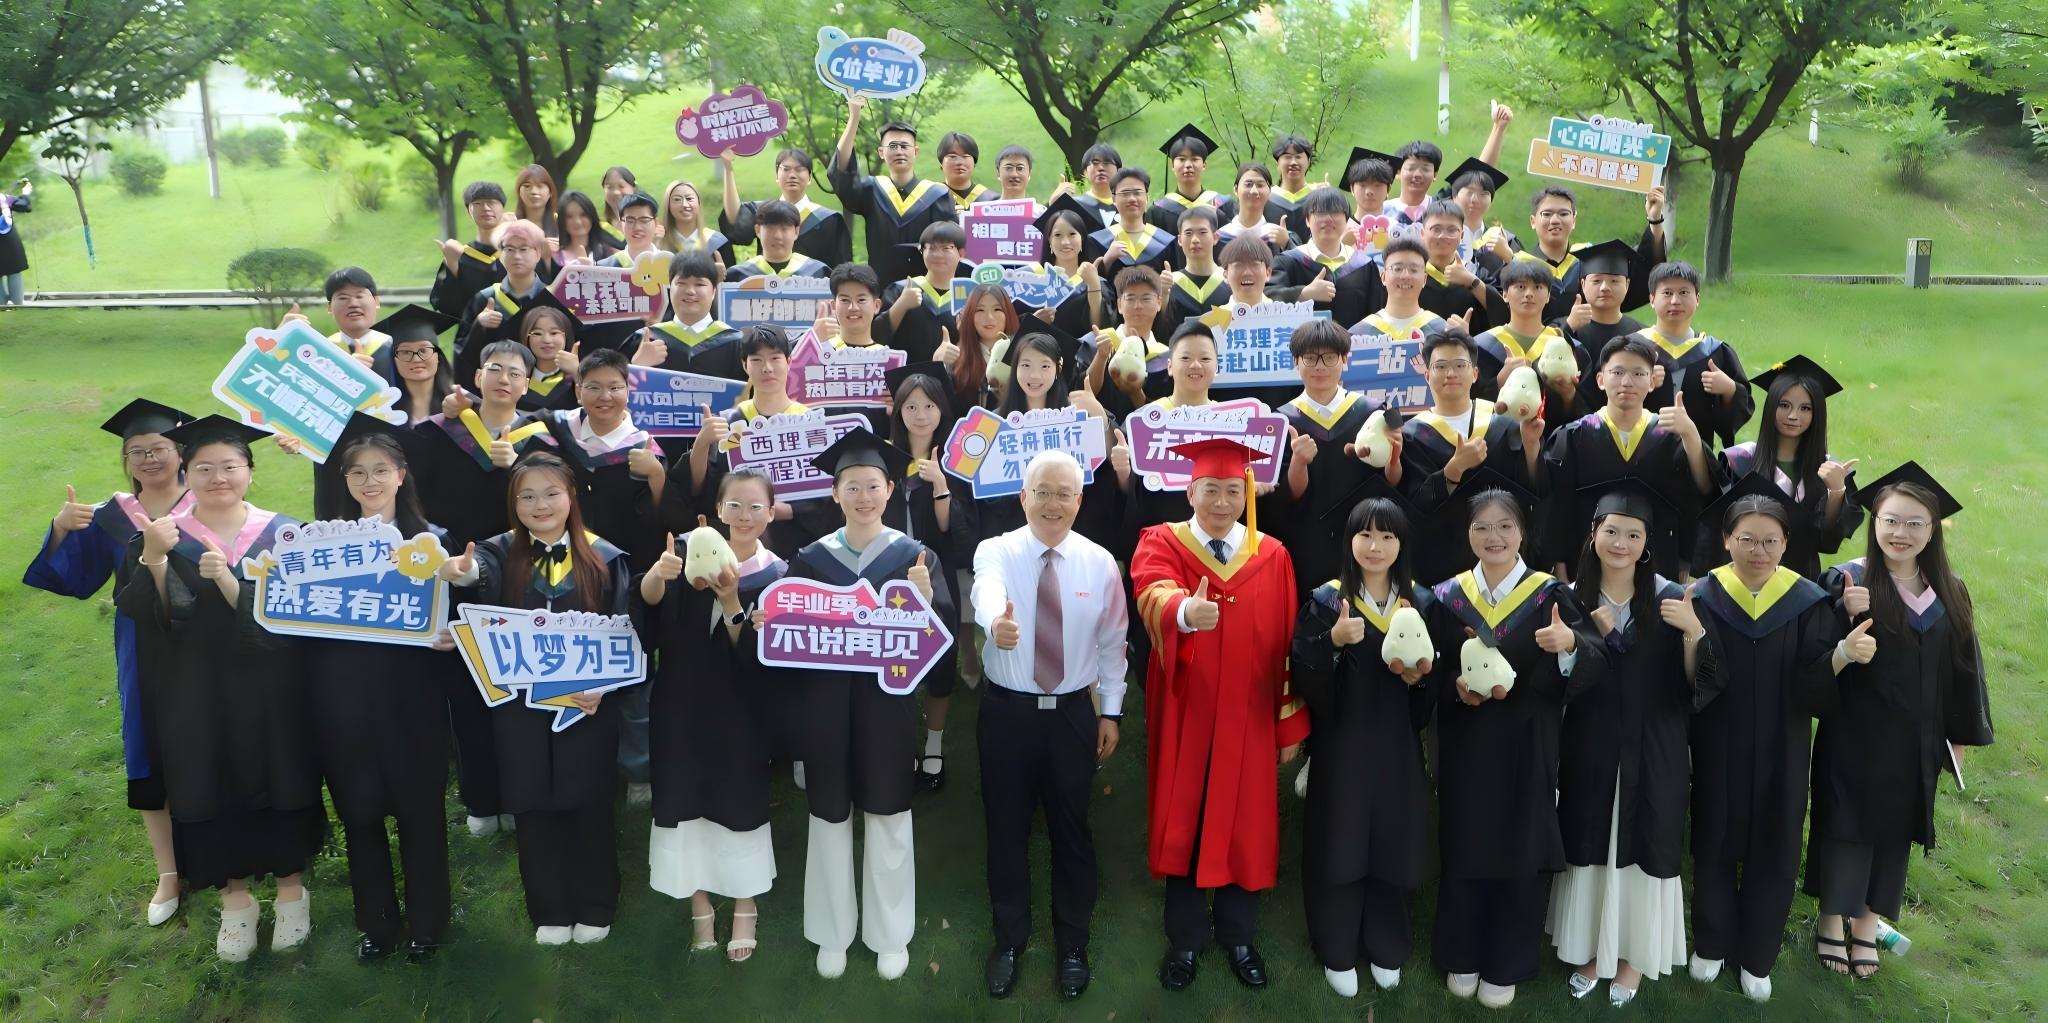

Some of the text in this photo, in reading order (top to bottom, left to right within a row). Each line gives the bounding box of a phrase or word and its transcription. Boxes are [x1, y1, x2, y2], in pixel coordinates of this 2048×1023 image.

[1557, 126, 1644, 158] 心向阳光
[1559, 153, 1639, 184] 不负韶华
[998, 426, 1082, 456] 轻舟前行
[280, 539, 392, 576] 青年有为
[265, 580, 423, 627] 热爱有光
[776, 591, 858, 616] 毕业季
[488, 631, 635, 677] 以梦为马
[770, 623, 920, 660] 不说再见
